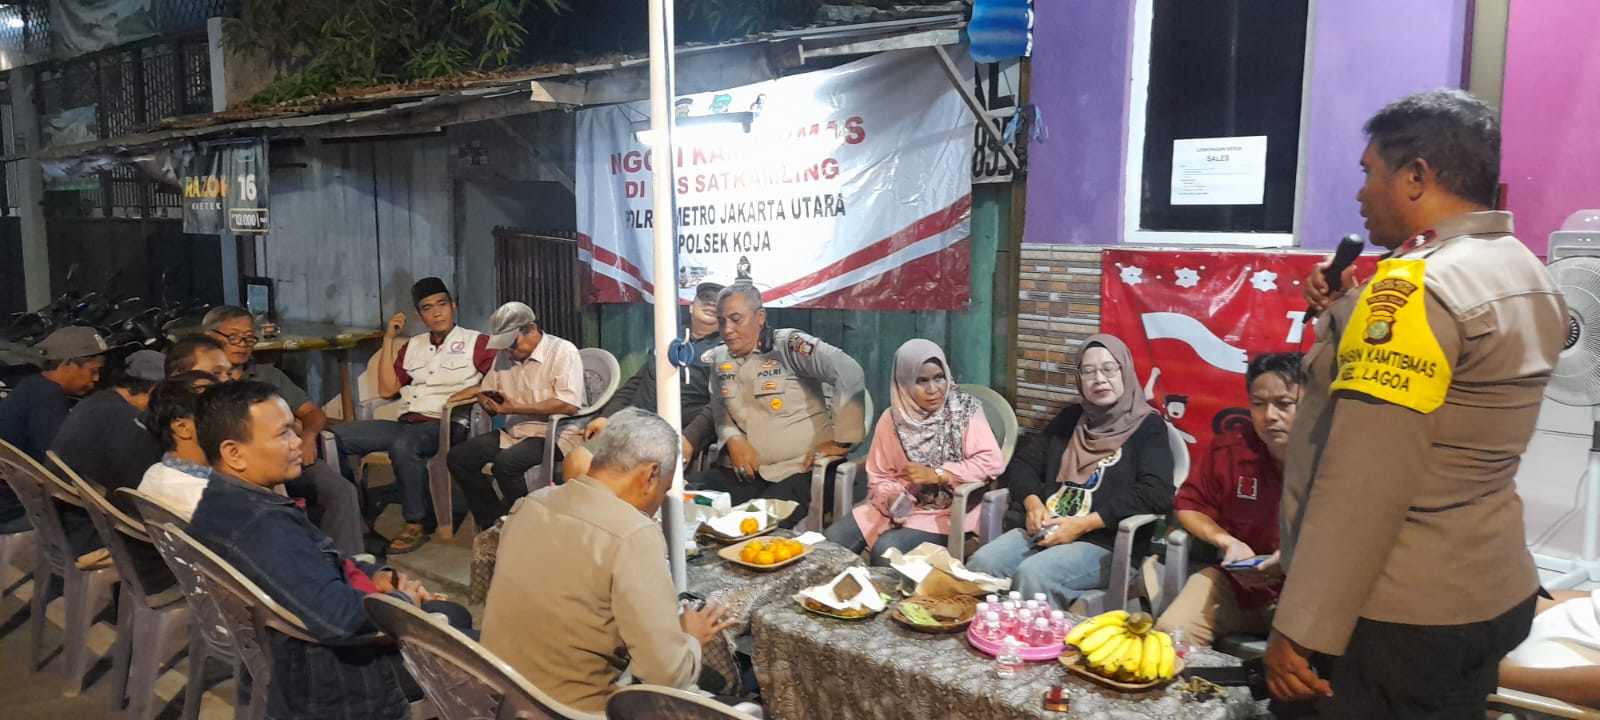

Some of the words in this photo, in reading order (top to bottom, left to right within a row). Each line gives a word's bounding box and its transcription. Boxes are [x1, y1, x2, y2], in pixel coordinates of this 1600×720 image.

[237, 174, 257, 200] 16
[625, 180, 645, 198] DI
[720, 199, 786, 224] JAKARTA
[791, 192, 847, 219] UTARA
[678, 233, 729, 255] POLSEK
[733, 230, 771, 252] KOJA
[1366, 348, 1437, 379] KAMTIBMAS
[1361, 368, 1410, 393] LAGOA
